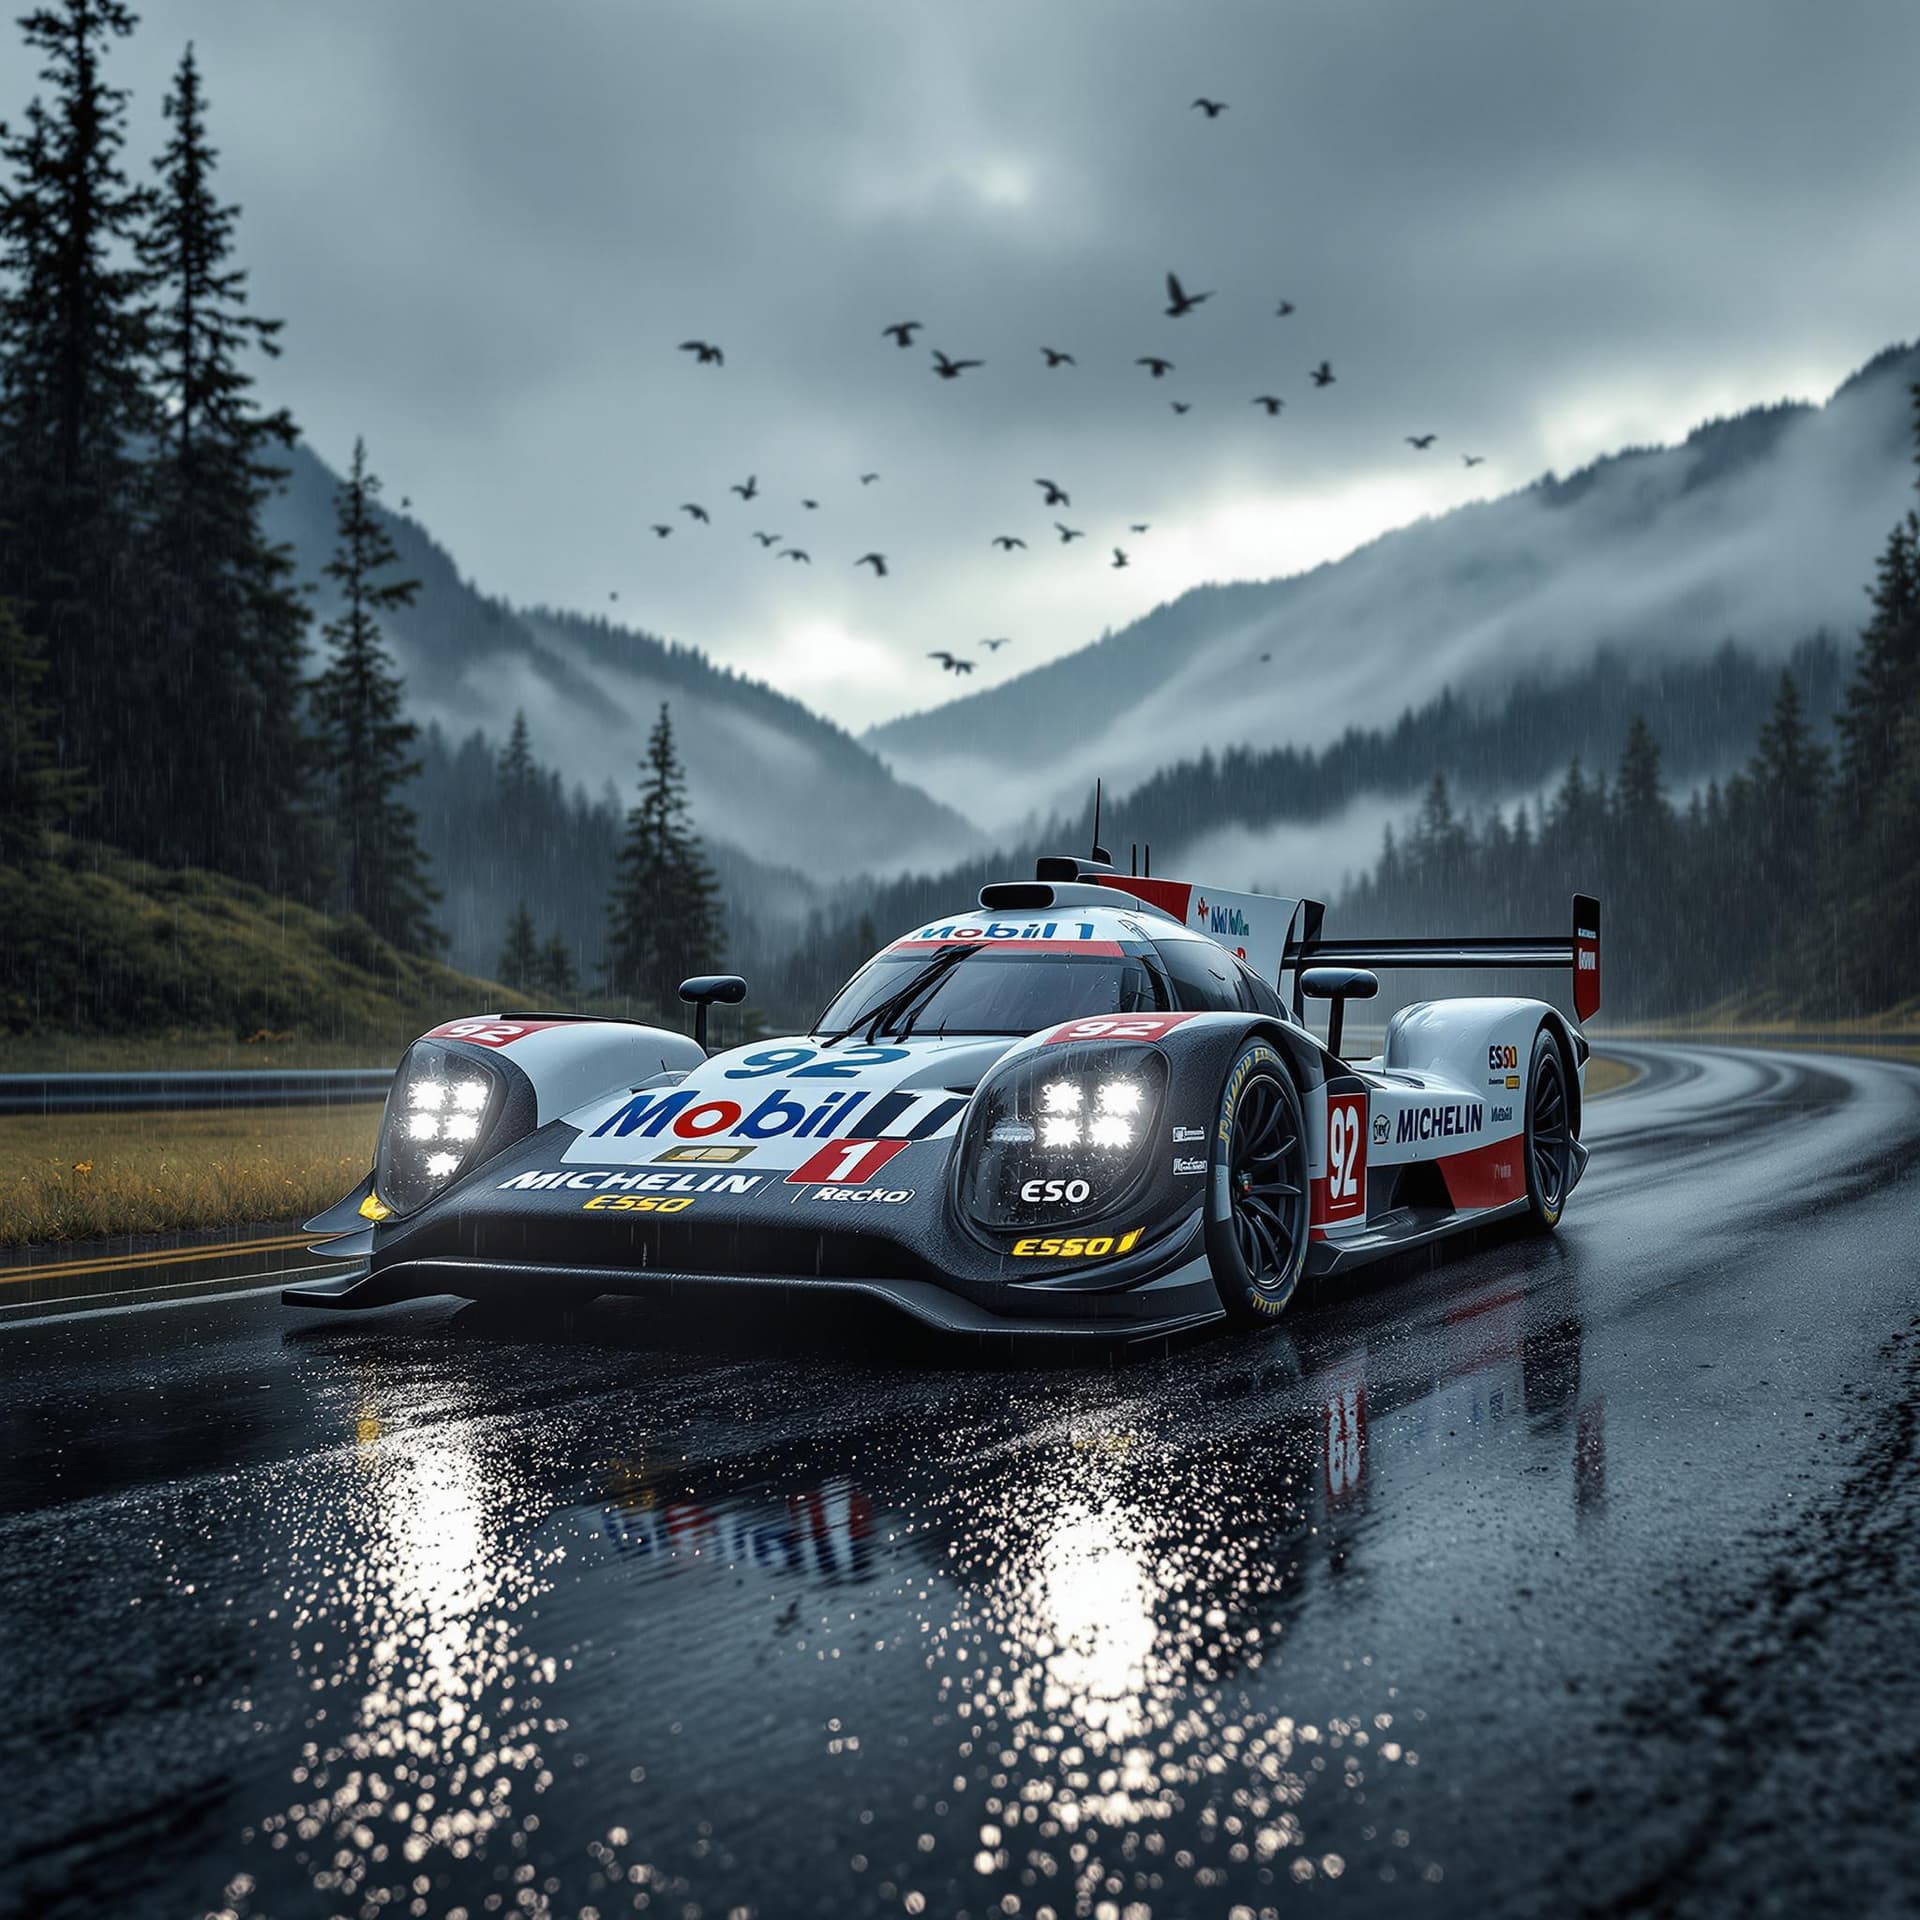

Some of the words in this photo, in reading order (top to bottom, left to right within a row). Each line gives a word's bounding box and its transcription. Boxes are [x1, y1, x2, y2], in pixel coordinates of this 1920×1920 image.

[911, 923, 1057, 940] Mobil
[1075, 923, 1094, 939] 1
[445, 1025, 523, 1042] 92
[1069, 1021, 1163, 1037] 92
[724, 1047, 911, 1079] 92
[590, 1090, 870, 1138] Mobil
[1396, 1103, 1482, 1144] MICHELIN
[826, 1140, 880, 1181] 1
[1329, 1104, 1359, 1200] 92
[497, 1170, 762, 1194] MICHELIN
[1020, 1179, 1090, 1203] ESO
[583, 1195, 695, 1214] ESSO
[1011, 1238, 1115, 1257] ESSO
